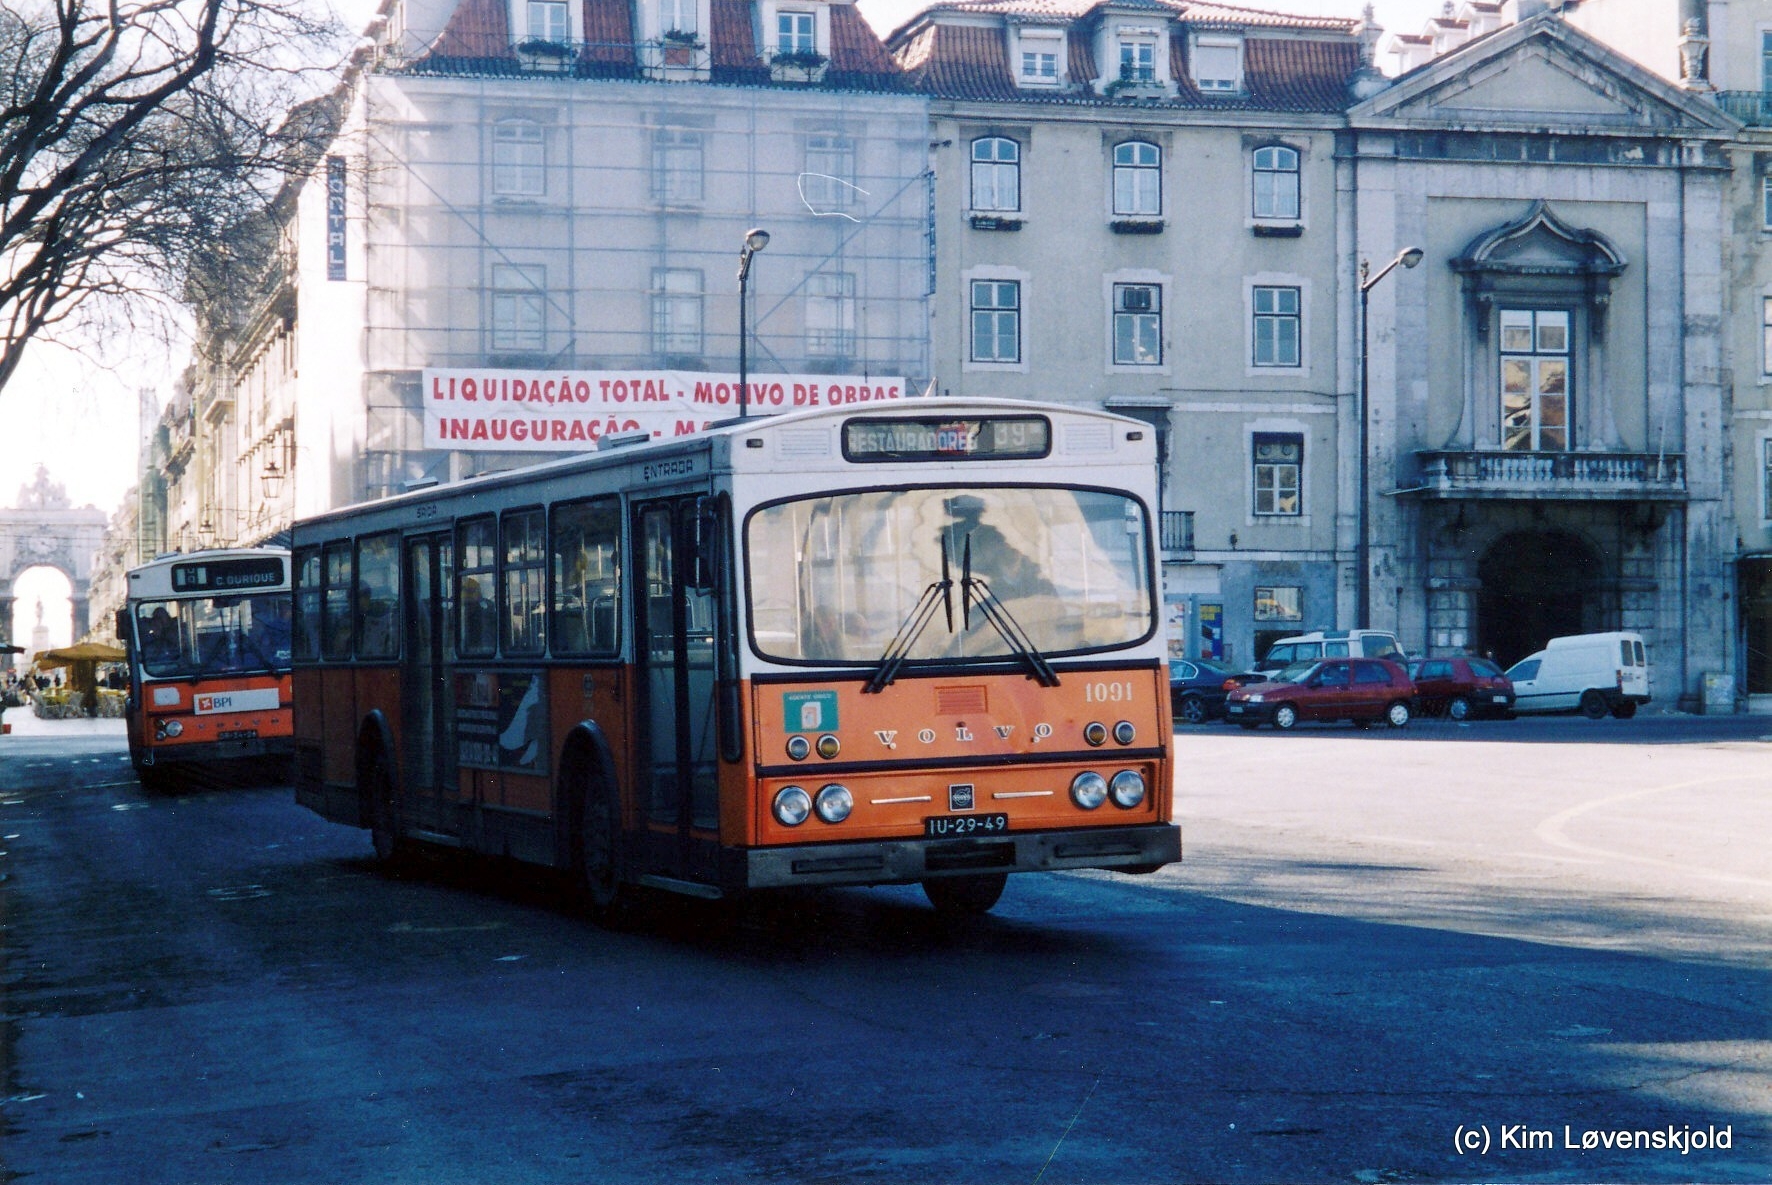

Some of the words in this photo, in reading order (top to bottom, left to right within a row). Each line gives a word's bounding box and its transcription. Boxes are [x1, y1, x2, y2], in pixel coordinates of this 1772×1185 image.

[433, 376, 590, 407] LIQUIDAÇÃO
[600, 379, 670, 403] TOTAL
[694, 382, 784, 406] MOTIVO
[793, 384, 819, 406] DE
[828, 384, 899, 406] OBRAS
[440, 415, 640, 446] INAUGURAÇÃO
[644, 459, 693, 481] ENTRADA
[213, 697, 232, 709] BPI
[1086, 682, 1132, 702] 1091
[874, 723, 1053, 745] VOLVO
[930, 816, 1005, 835] IU-29-49
